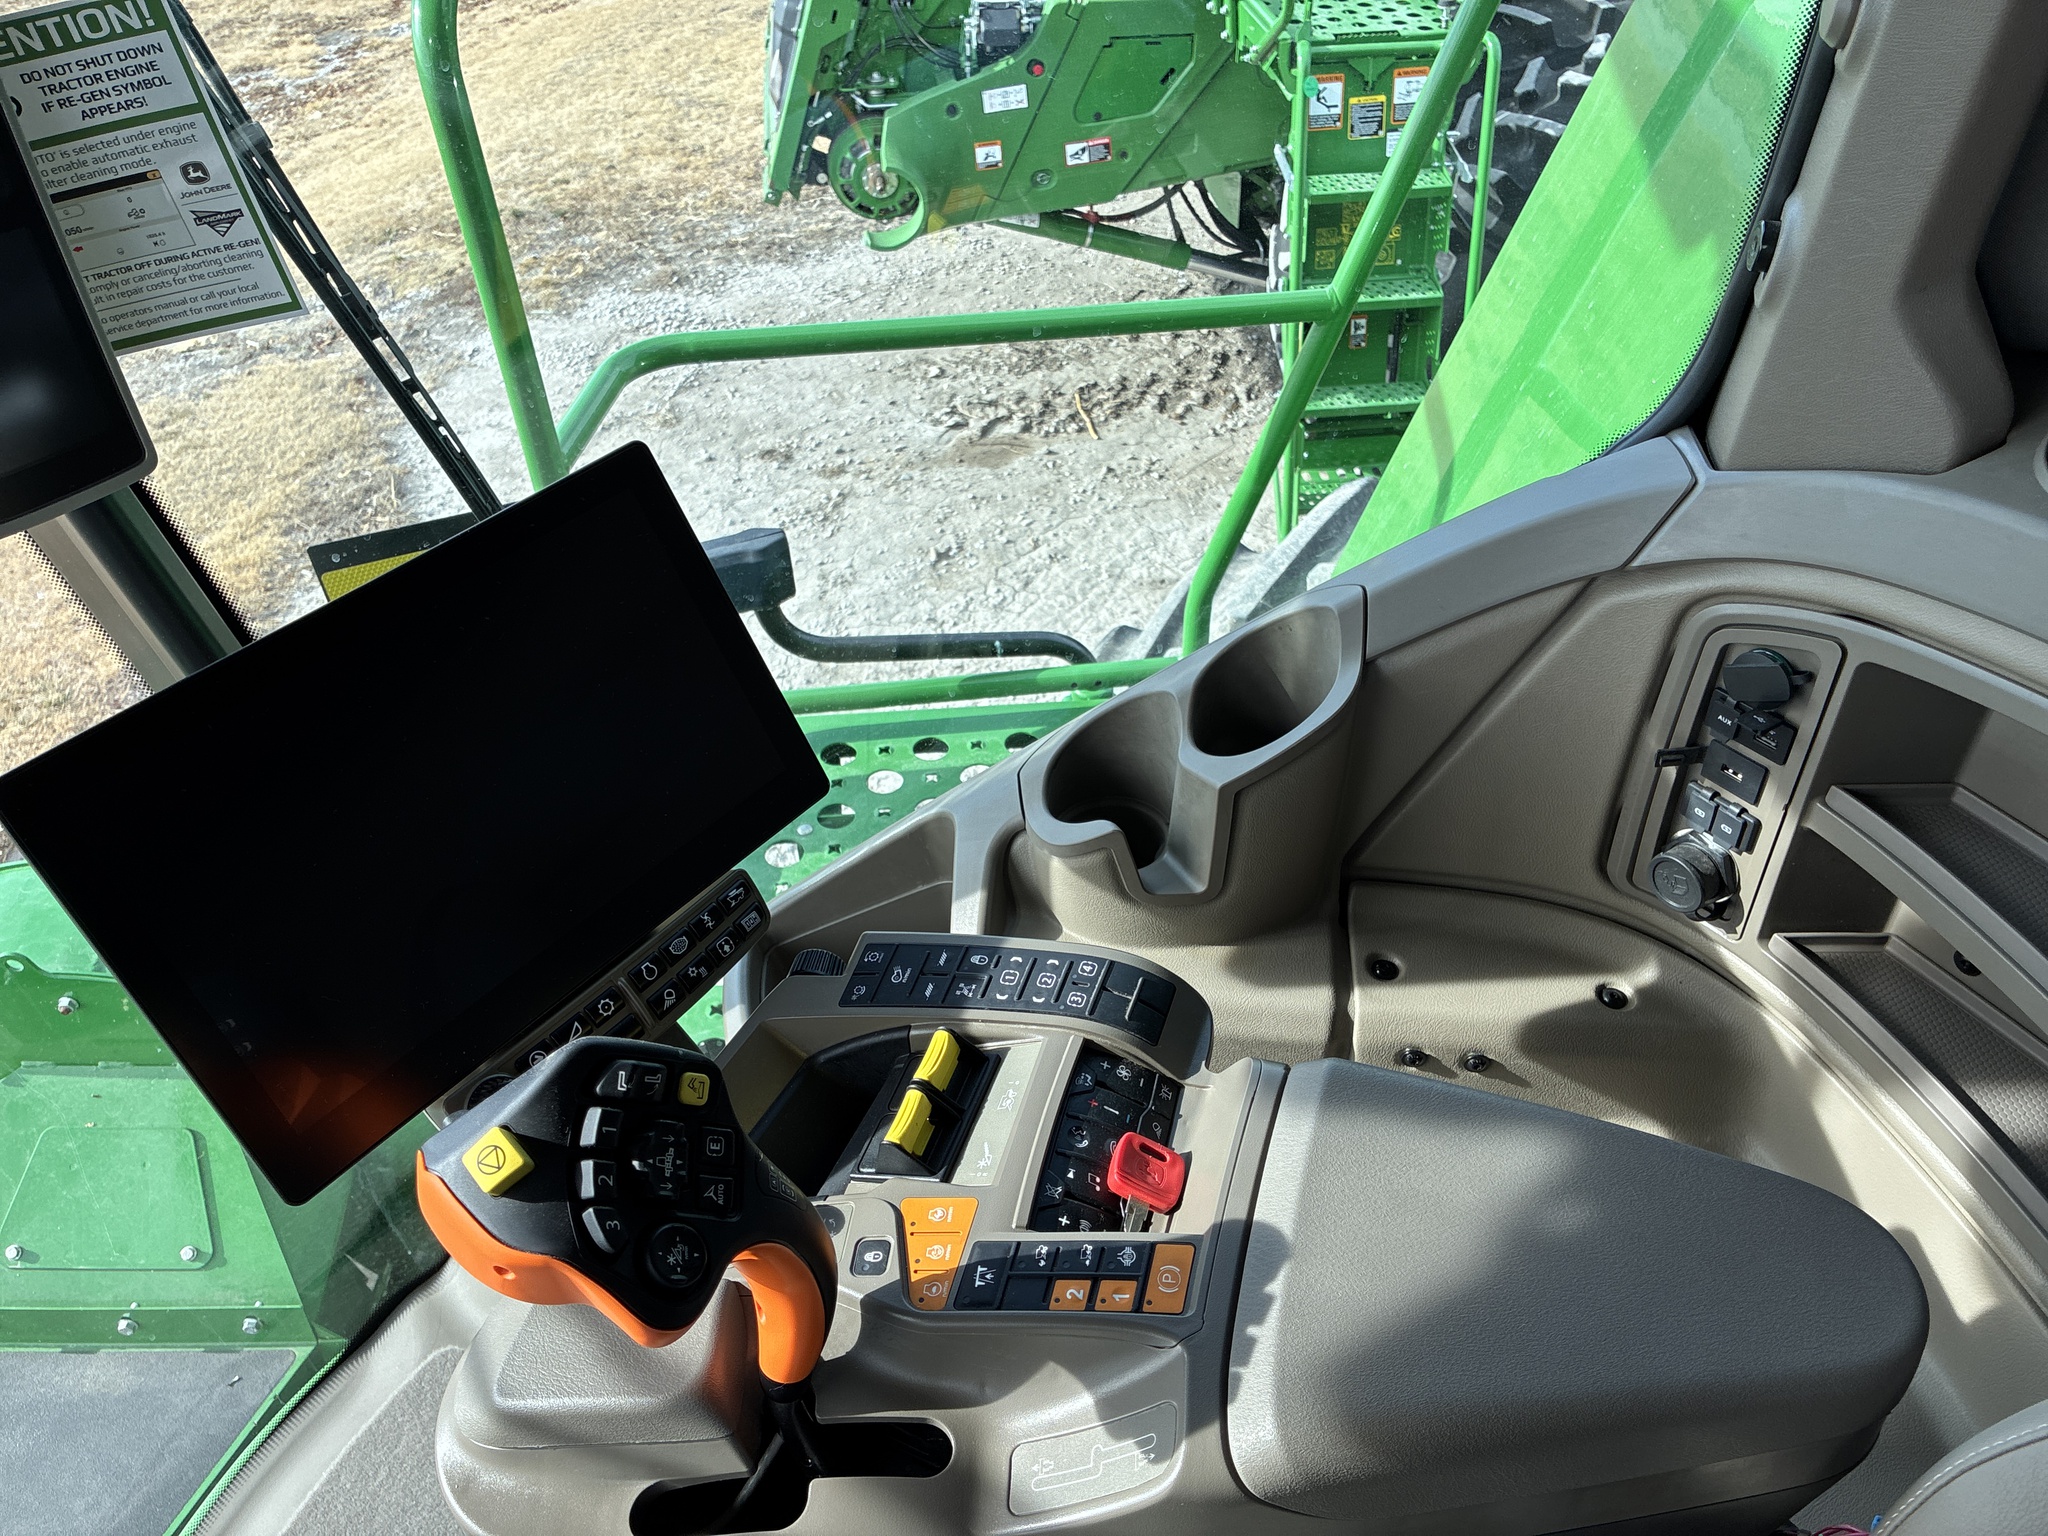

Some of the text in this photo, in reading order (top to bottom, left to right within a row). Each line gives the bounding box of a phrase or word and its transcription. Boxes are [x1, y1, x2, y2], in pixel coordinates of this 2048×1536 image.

[19, 42, 164, 84] DO NOT SHUT DOWN
[38, 60, 160, 97] TRACTOR ENGINE
[41, 75, 172, 113] IF RE-GEN SYMBOL
[81, 96, 148, 121] APPEARS!
[59, 149, 70, 160] is
[73, 135, 121, 156] selected
[122, 129, 155, 144] under
[158, 121, 197, 136] engine
[51, 158, 90, 175] enable
[91, 143, 151, 165] automatic
[152, 133, 199, 151] exhaust
[70, 165, 119, 184] cleaning
[120, 156, 157, 171] mode.
[180, 183, 232, 199] JOHN DEERE
[89, 249, 264, 294] omply or canceling/aborting cleaning
[90, 265, 134, 281] TRACTOR
[134, 260, 153, 271] OFF
[153, 252, 190, 267] DURING
[191, 245, 224, 259] ACTIVE
[223, 237, 262, 251] RE-GEN!
[105, 293, 116, 302] in
[117, 286, 144, 299] repair
[146, 280, 172, 292] costs
[172, 275, 188, 287] for
[188, 271, 206, 283] the
[207, 263, 255, 279] customer.
[106, 290, 286, 336] ervice department for more information.
[109, 306, 154, 323] operators
[153, 296, 189, 311] manual
[189, 295, 199, 304] or
[200, 291, 216, 302] call
[216, 287, 237, 299] your
[237, 281, 260, 293] local
[1717, 714, 1732, 726] AUX
[1070, 996, 1082, 1004] 3
[601, 1125, 617, 1133] 1
[709, 1142, 721, 1151] E
[598, 1174, 614, 1187] 2
[605, 1219, 621, 1231] 3
[1162, 1273, 1176, 1283] P
[1066, 1288, 1084, 1301] 2
[1112, 1293, 1130, 1302] 1
